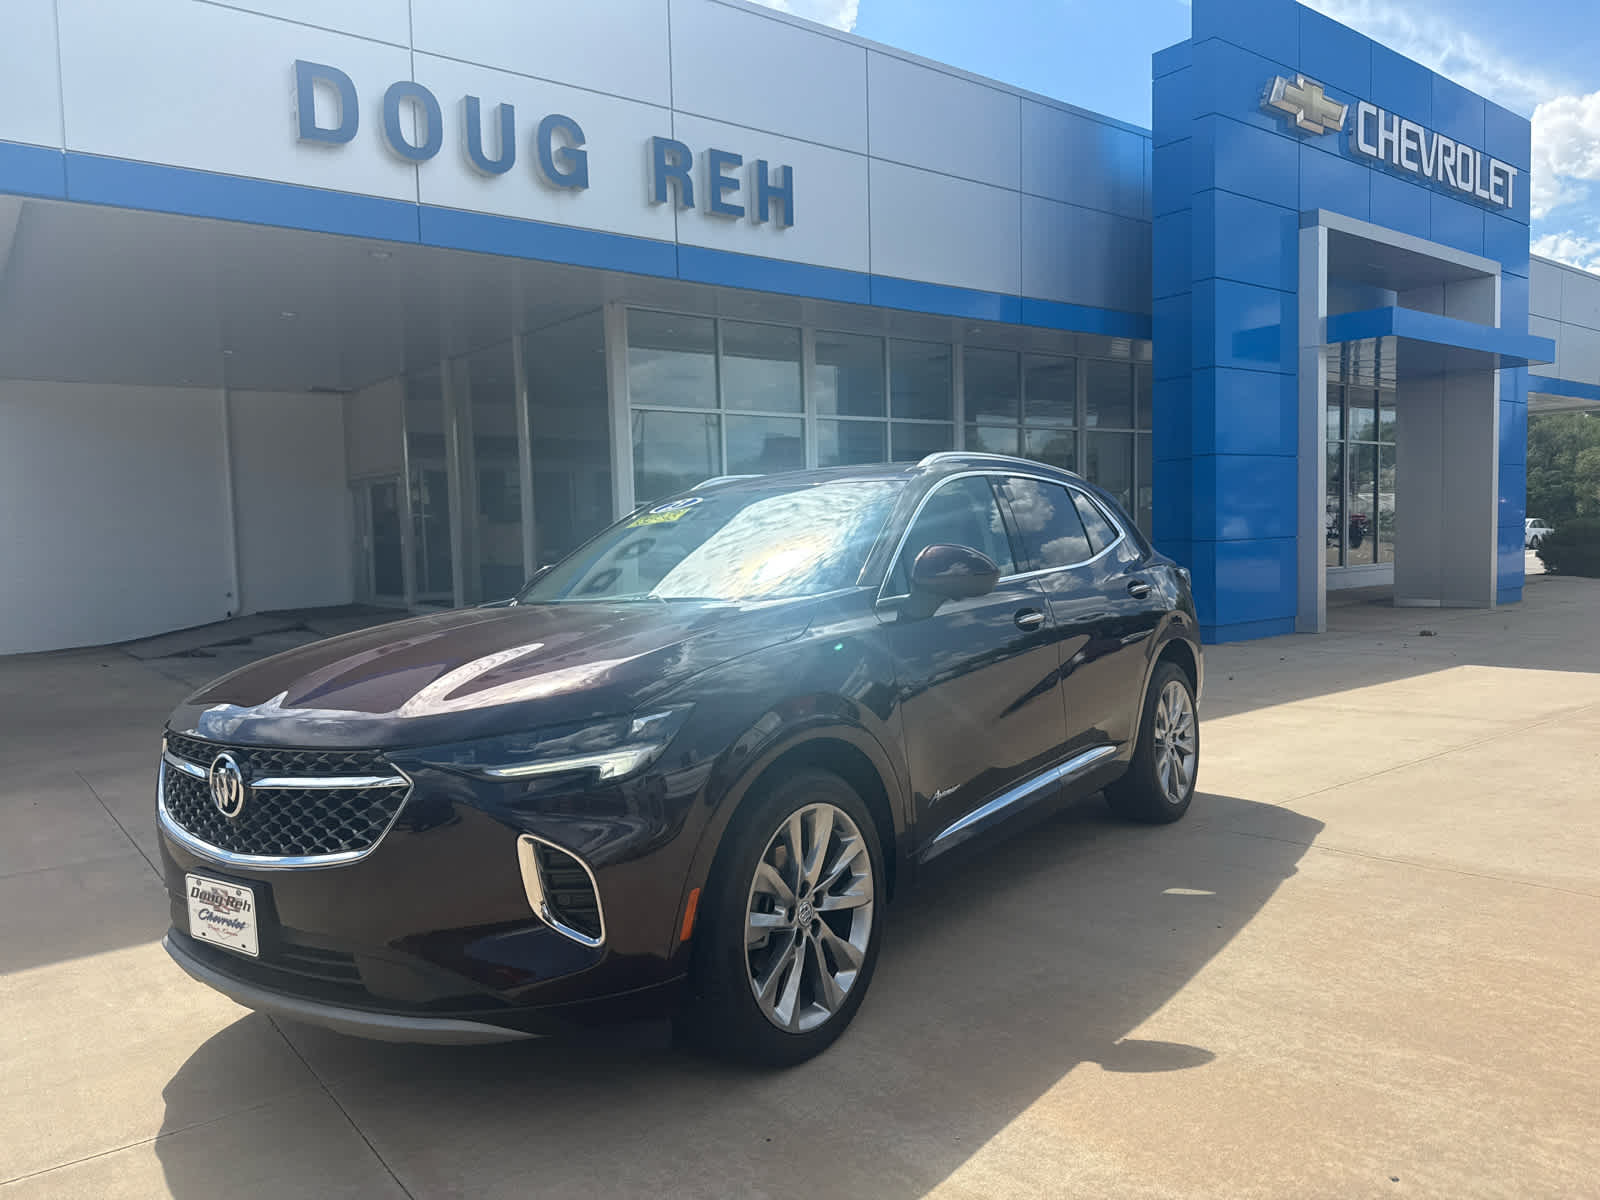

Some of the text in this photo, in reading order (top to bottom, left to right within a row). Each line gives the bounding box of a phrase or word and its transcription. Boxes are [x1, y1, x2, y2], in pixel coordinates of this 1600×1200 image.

[293, 59, 795, 228] DOUG REH
[1356, 99, 1518, 209] CHEVROLET
[191, 887, 251, 912] Doug Reh
